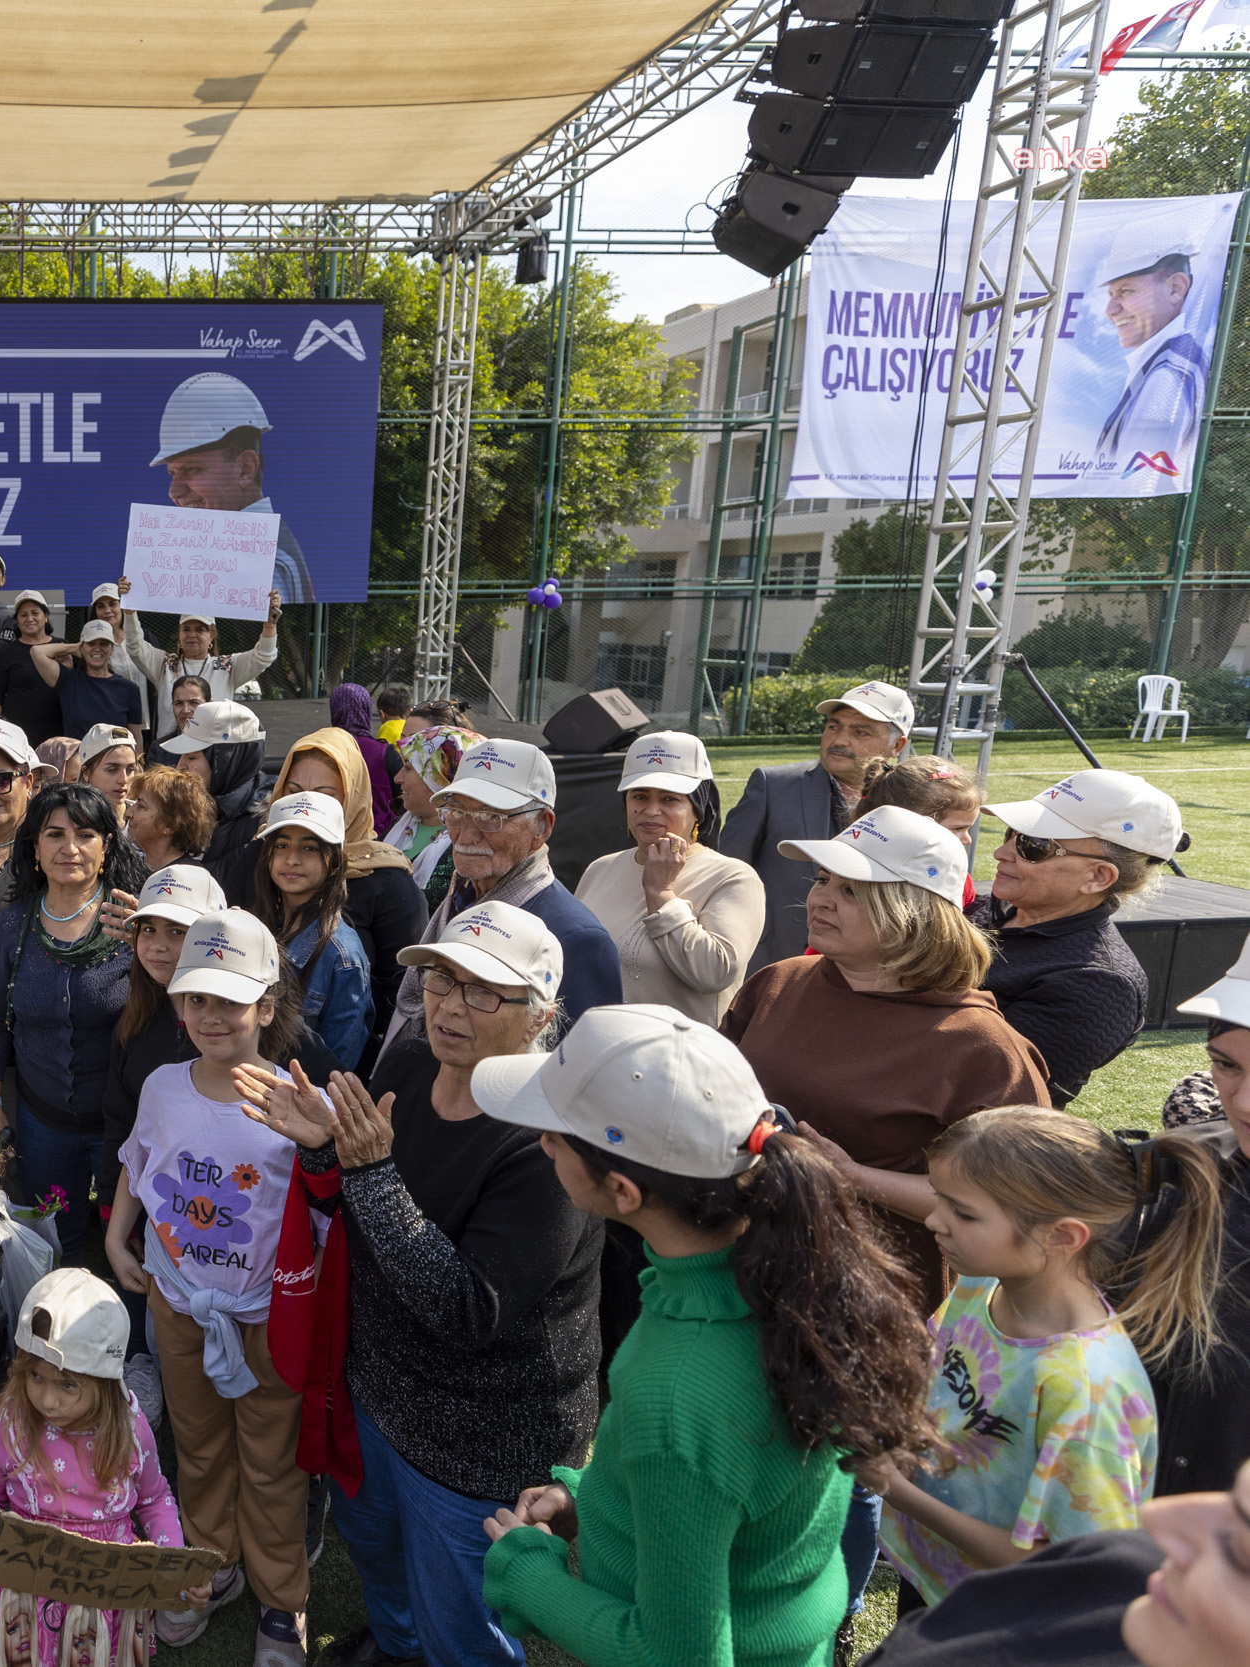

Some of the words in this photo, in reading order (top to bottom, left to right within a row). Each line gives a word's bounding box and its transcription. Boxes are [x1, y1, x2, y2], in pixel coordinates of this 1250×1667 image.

[200, 327, 243, 357] Vahap
[1058, 450, 1093, 478] Vahap
[139, 512, 160, 529] HER
[132, 532, 154, 547] HER
[149, 551, 182, 570] HER
[142, 572, 219, 598] VAHAP
[481, 922, 512, 939] BELEDİYESİ
[183, 1157, 222, 1188] TER
[172, 1192, 234, 1228] DAYS
[182, 1242, 253, 1271] AREAL
